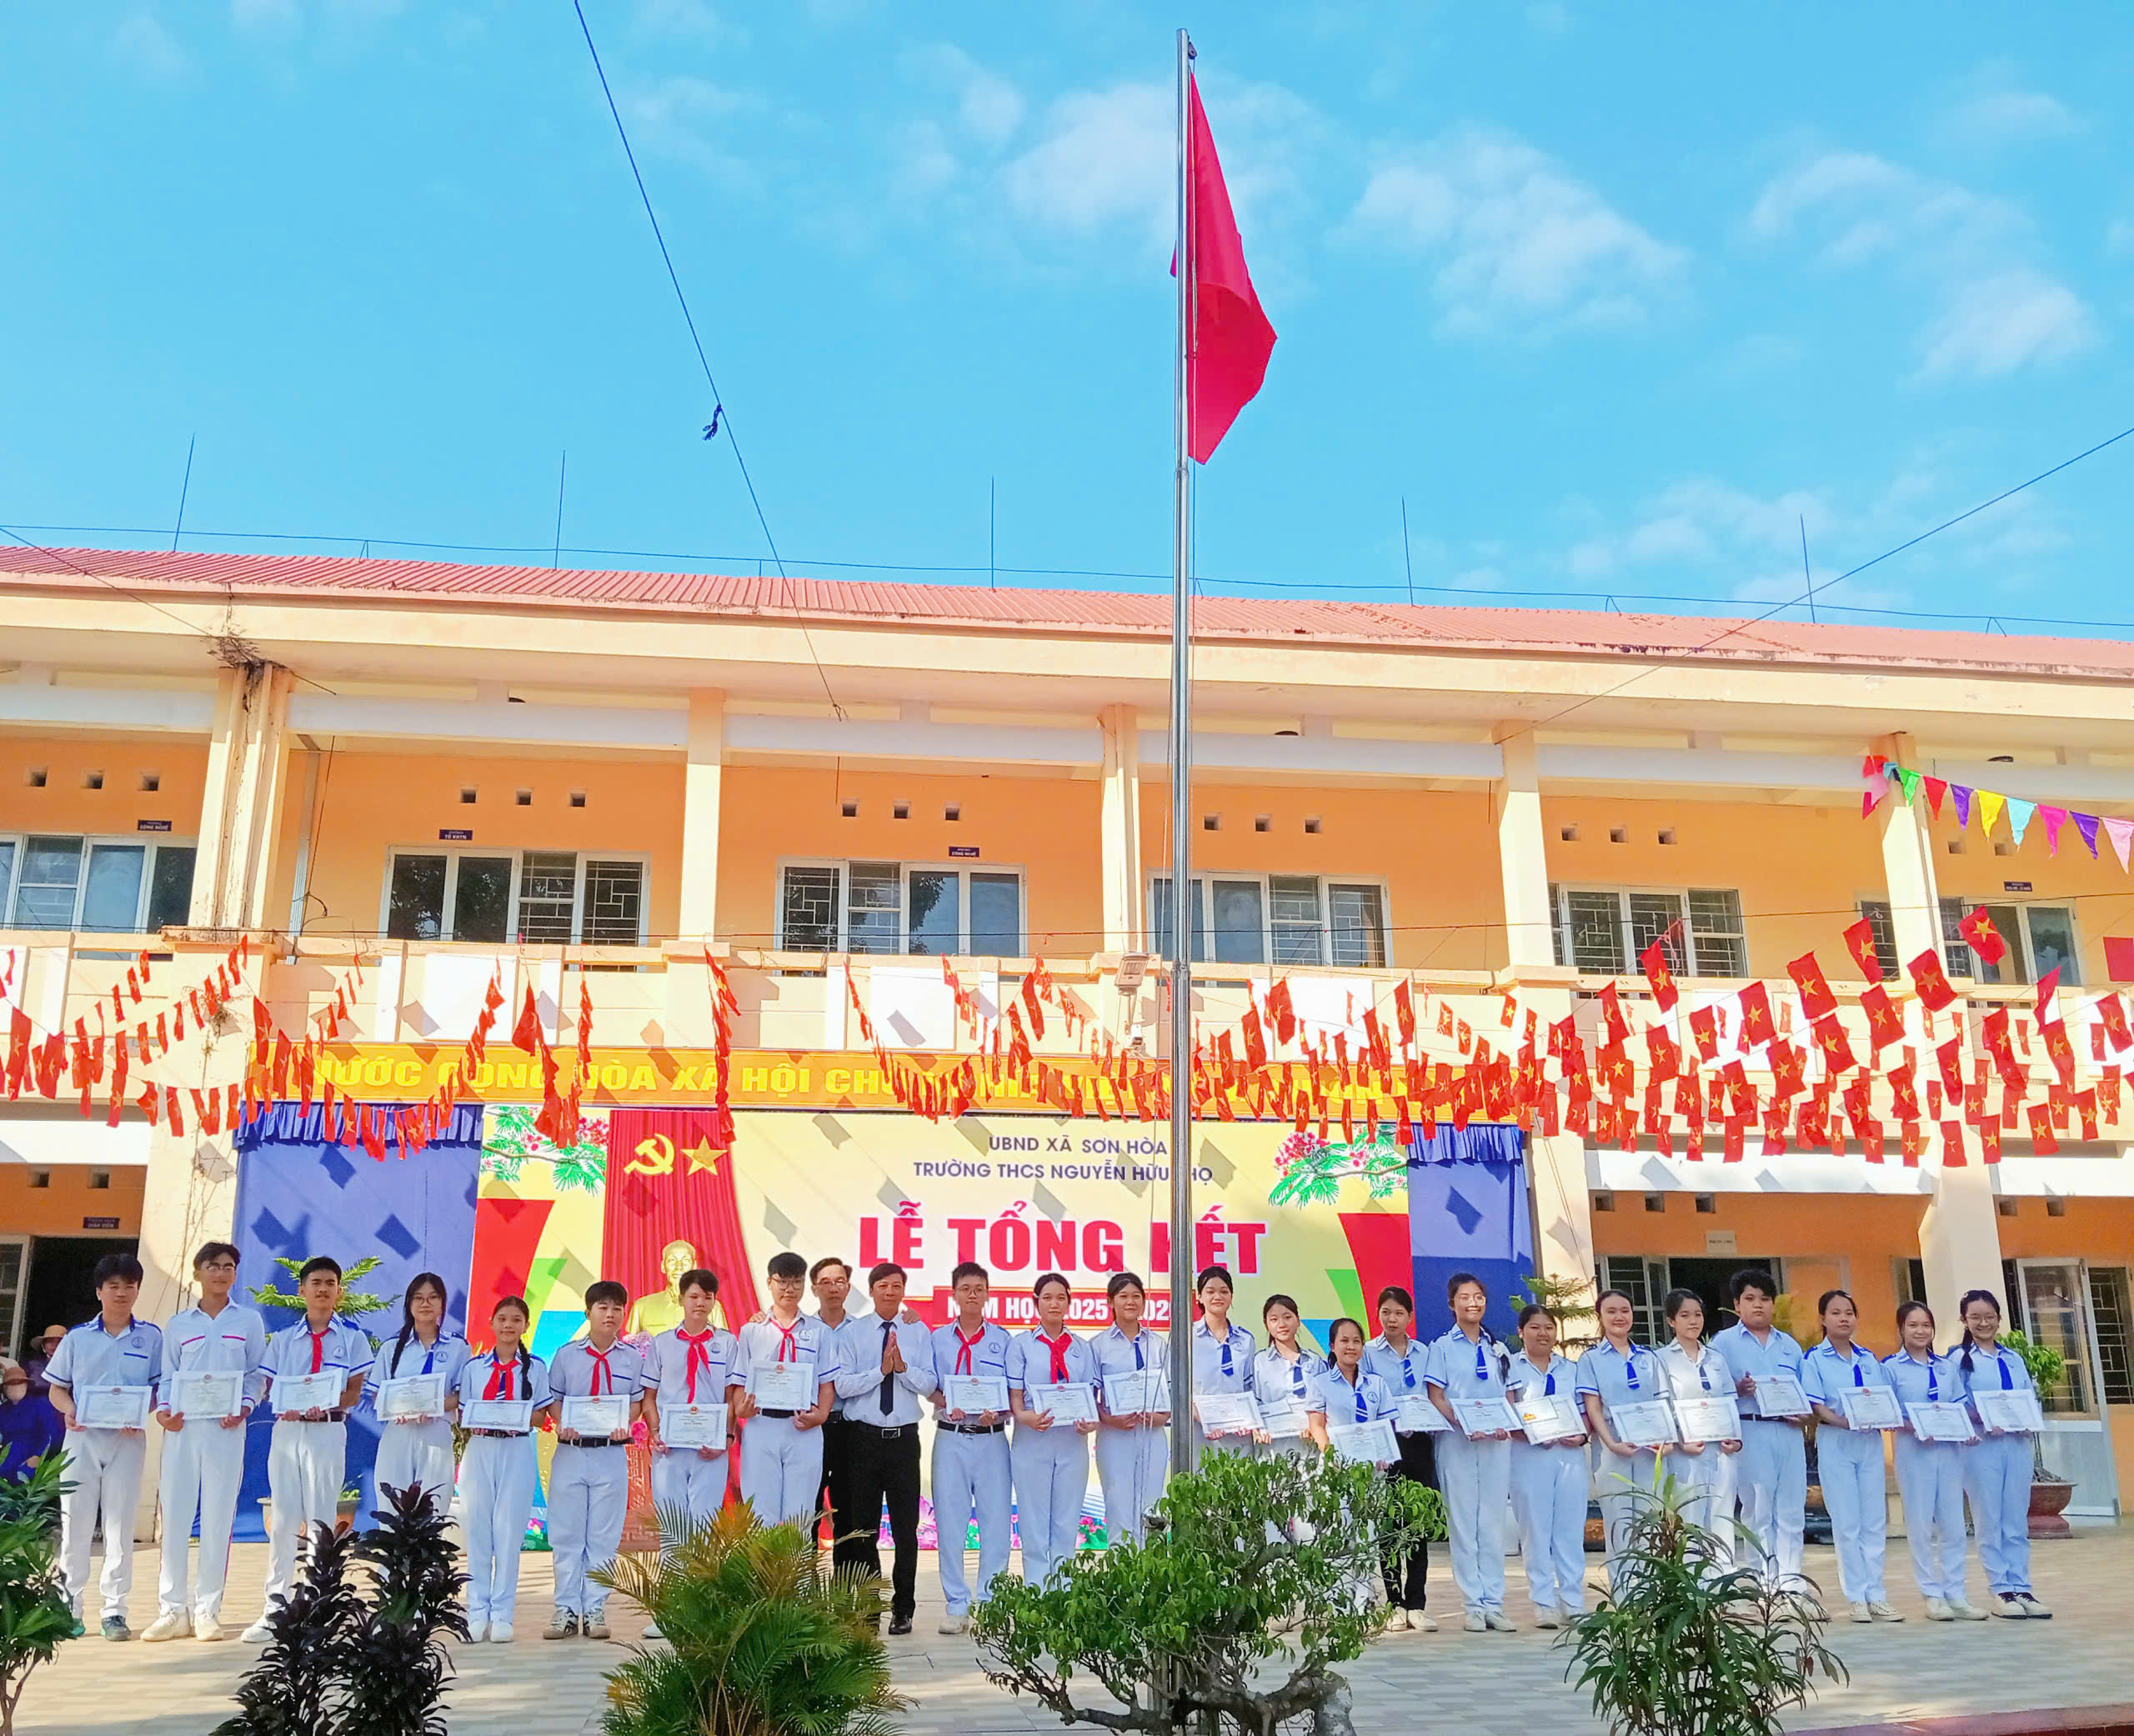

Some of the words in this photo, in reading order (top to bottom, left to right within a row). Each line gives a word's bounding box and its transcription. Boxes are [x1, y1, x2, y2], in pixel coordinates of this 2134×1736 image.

[741, 1062, 811, 1098] HỘI
[988, 1136, 1039, 1152] UBND
[1045, 1133, 1073, 1152] XÃ
[1081, 1138, 1120, 1154] SƠN
[1126, 1136, 1168, 1155] HÒA
[913, 1158, 991, 1178] TRƯỜNG
[997, 1163, 1045, 1179] THCS
[1050, 1159, 1125, 1181] NGUYỄN
[1132, 1163, 1170, 1181] HỮU
[859, 1200, 924, 1269] LỄ
[947, 1200, 1125, 1273] TỔNG
[947, 1296, 999, 1318] NM
[1005, 1297, 1042, 1324] HỌ
[1063, 1298, 1109, 1320] 025
[1137, 1298, 1172, 1321] 02
